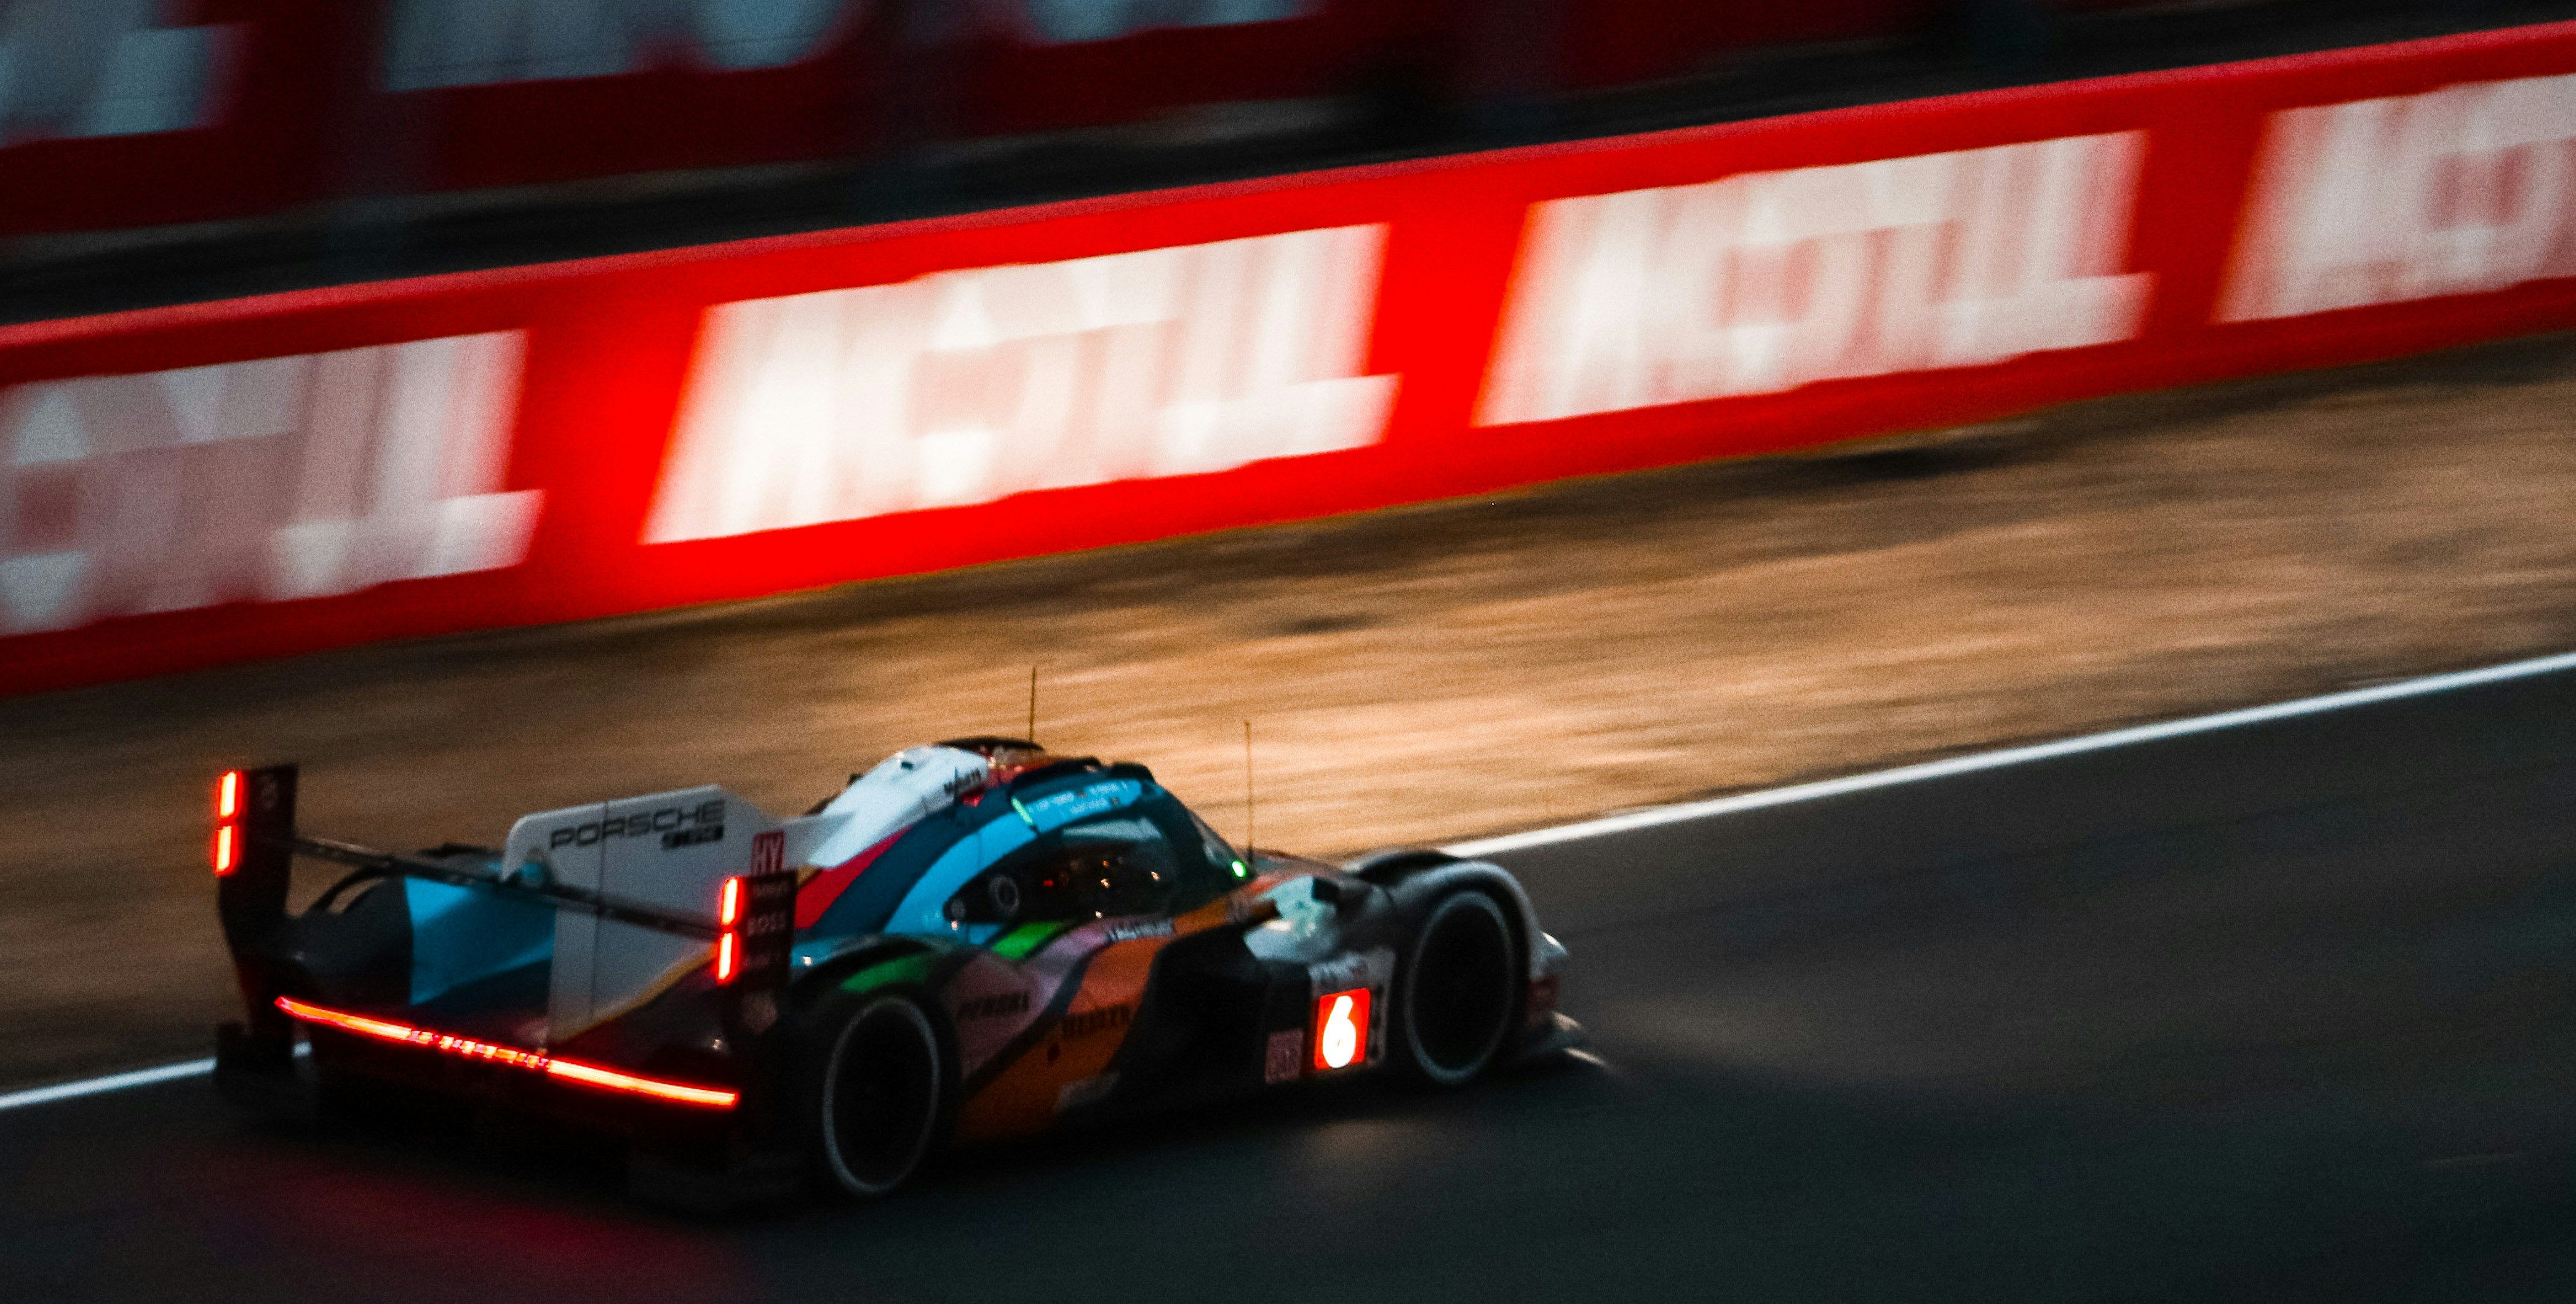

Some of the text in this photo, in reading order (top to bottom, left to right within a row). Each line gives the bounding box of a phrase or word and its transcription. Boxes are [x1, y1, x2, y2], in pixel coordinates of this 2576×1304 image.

[549, 799, 726, 849] PORSCHE
[752, 835, 783, 876] HY
[1322, 994, 1357, 1068] 6
